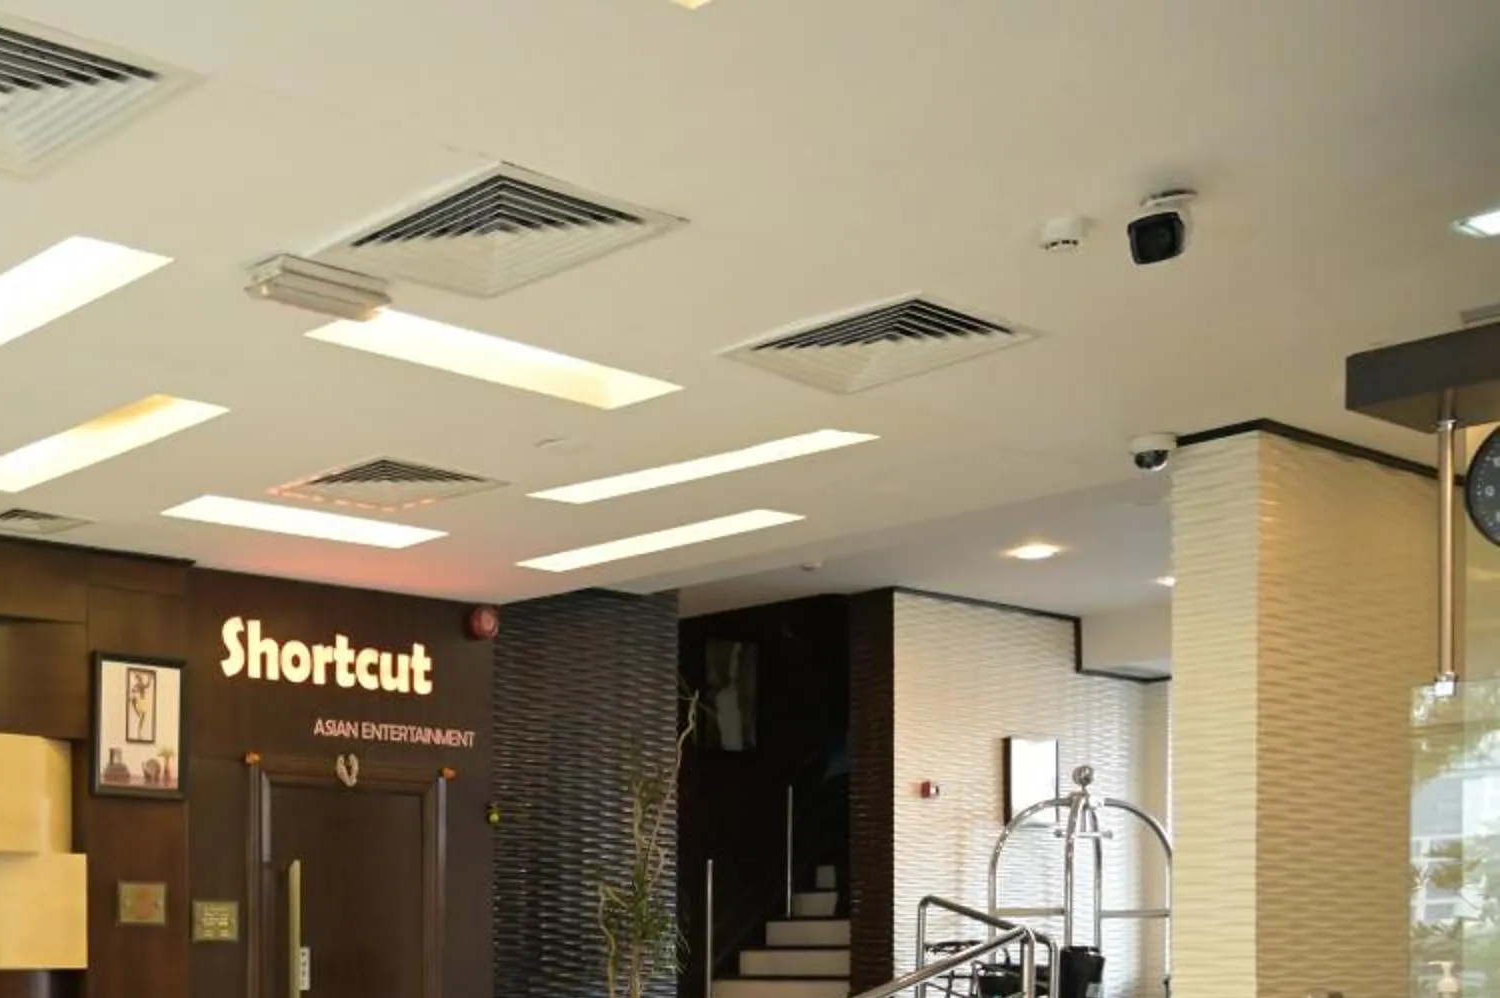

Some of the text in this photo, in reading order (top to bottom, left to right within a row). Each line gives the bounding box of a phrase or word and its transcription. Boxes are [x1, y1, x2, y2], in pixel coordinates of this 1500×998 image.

[220, 616, 433, 695] Shortcut
[313, 717, 476, 749] ASIAN ENTERTAINMENT
